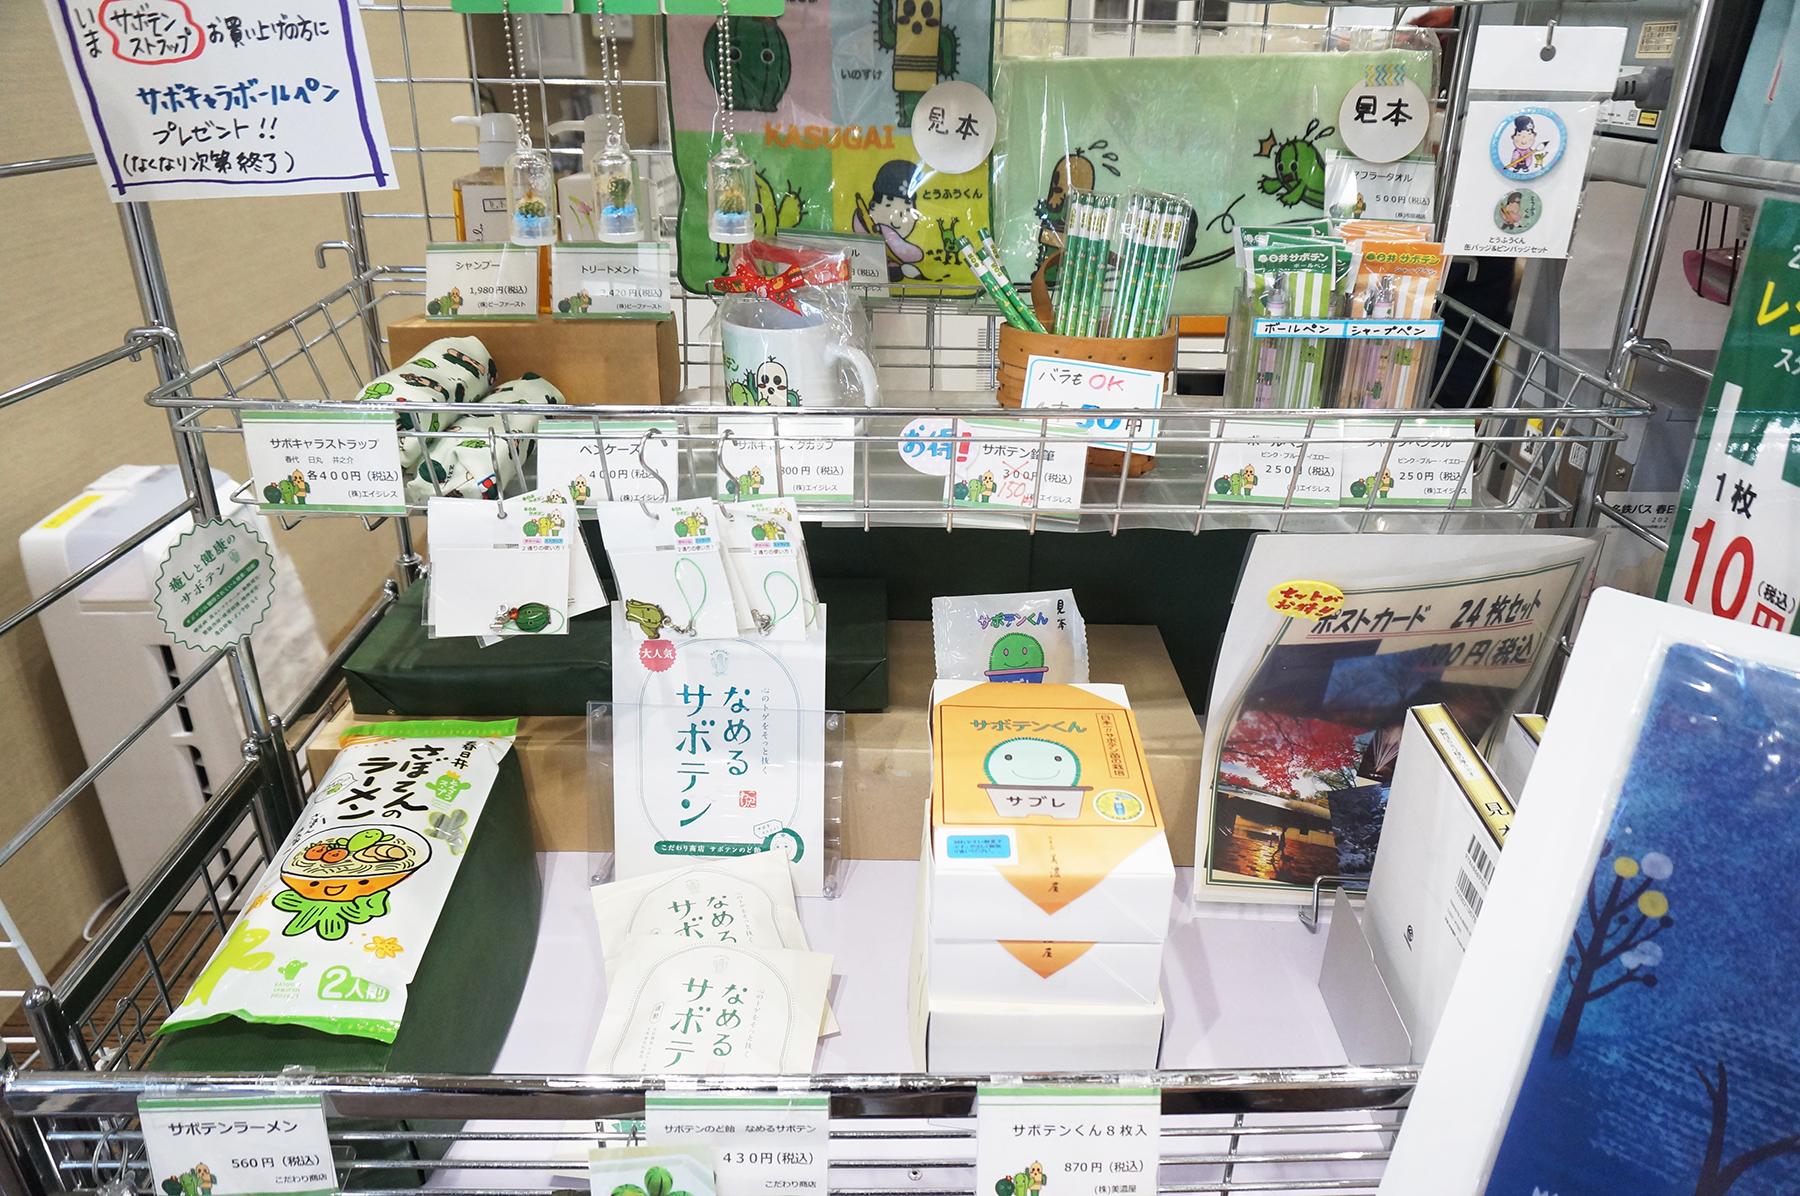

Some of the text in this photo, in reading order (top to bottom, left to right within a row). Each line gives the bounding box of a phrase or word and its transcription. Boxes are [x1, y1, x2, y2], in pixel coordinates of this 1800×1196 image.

[75, 8, 103, 58] いま
[109, 8, 178, 38] サボテン
[206, 15, 331, 48] お買い上げの方に
[129, 28, 193, 58] ストラップ
[840, 69, 883, 81] いのすけ
[136, 77, 340, 115] サボキャラボールペン
[1354, 95, 1413, 127] 見本
[763, 121, 896, 151] KASUGAI
[928, 106, 980, 141] 見本
[122, 150, 296, 175] (なくなり次第終了)
[922, 189, 983, 201] とうふうくん
[455, 260, 500, 272] シャンプー
[581, 264, 640, 274] トリートメント
[1264, 322, 1331, 334] ボールペン
[269, 437, 378, 450] サボキャラストラップ
[982, 443, 1056, 462] サボテン鉛筆
[1715, 471, 1757, 520] 1枚
[168, 533, 237, 593] 癒しと健康の
[180, 562, 226, 605] サボテン
[1757, 580, 1797, 615] (税込)
[977, 611, 1049, 630] サボテンくん
[1310, 588, 1542, 634] ポストカード 24枚セット
[641, 647, 675, 660] 大人気
[722, 686, 752, 776] なめる
[969, 717, 1088, 734] サボテンくん
[450, 740, 477, 770] 春日井
[675, 683, 716, 828] サボテン
[336, 756, 399, 820] ラーメン
[1006, 795, 1066, 809] サブレ
[716, 983, 749, 1057] なめる
[167, 1120, 298, 1137] サボテンラーメン
[664, 1123, 817, 1134] サボテンのど飴 なめるサボテン
[1012, 1124, 1148, 1138] サボテンくん8枚入
[275, 1174, 328, 1185] こだわり商店
[764, 1179, 817, 1189] こだわり商店
